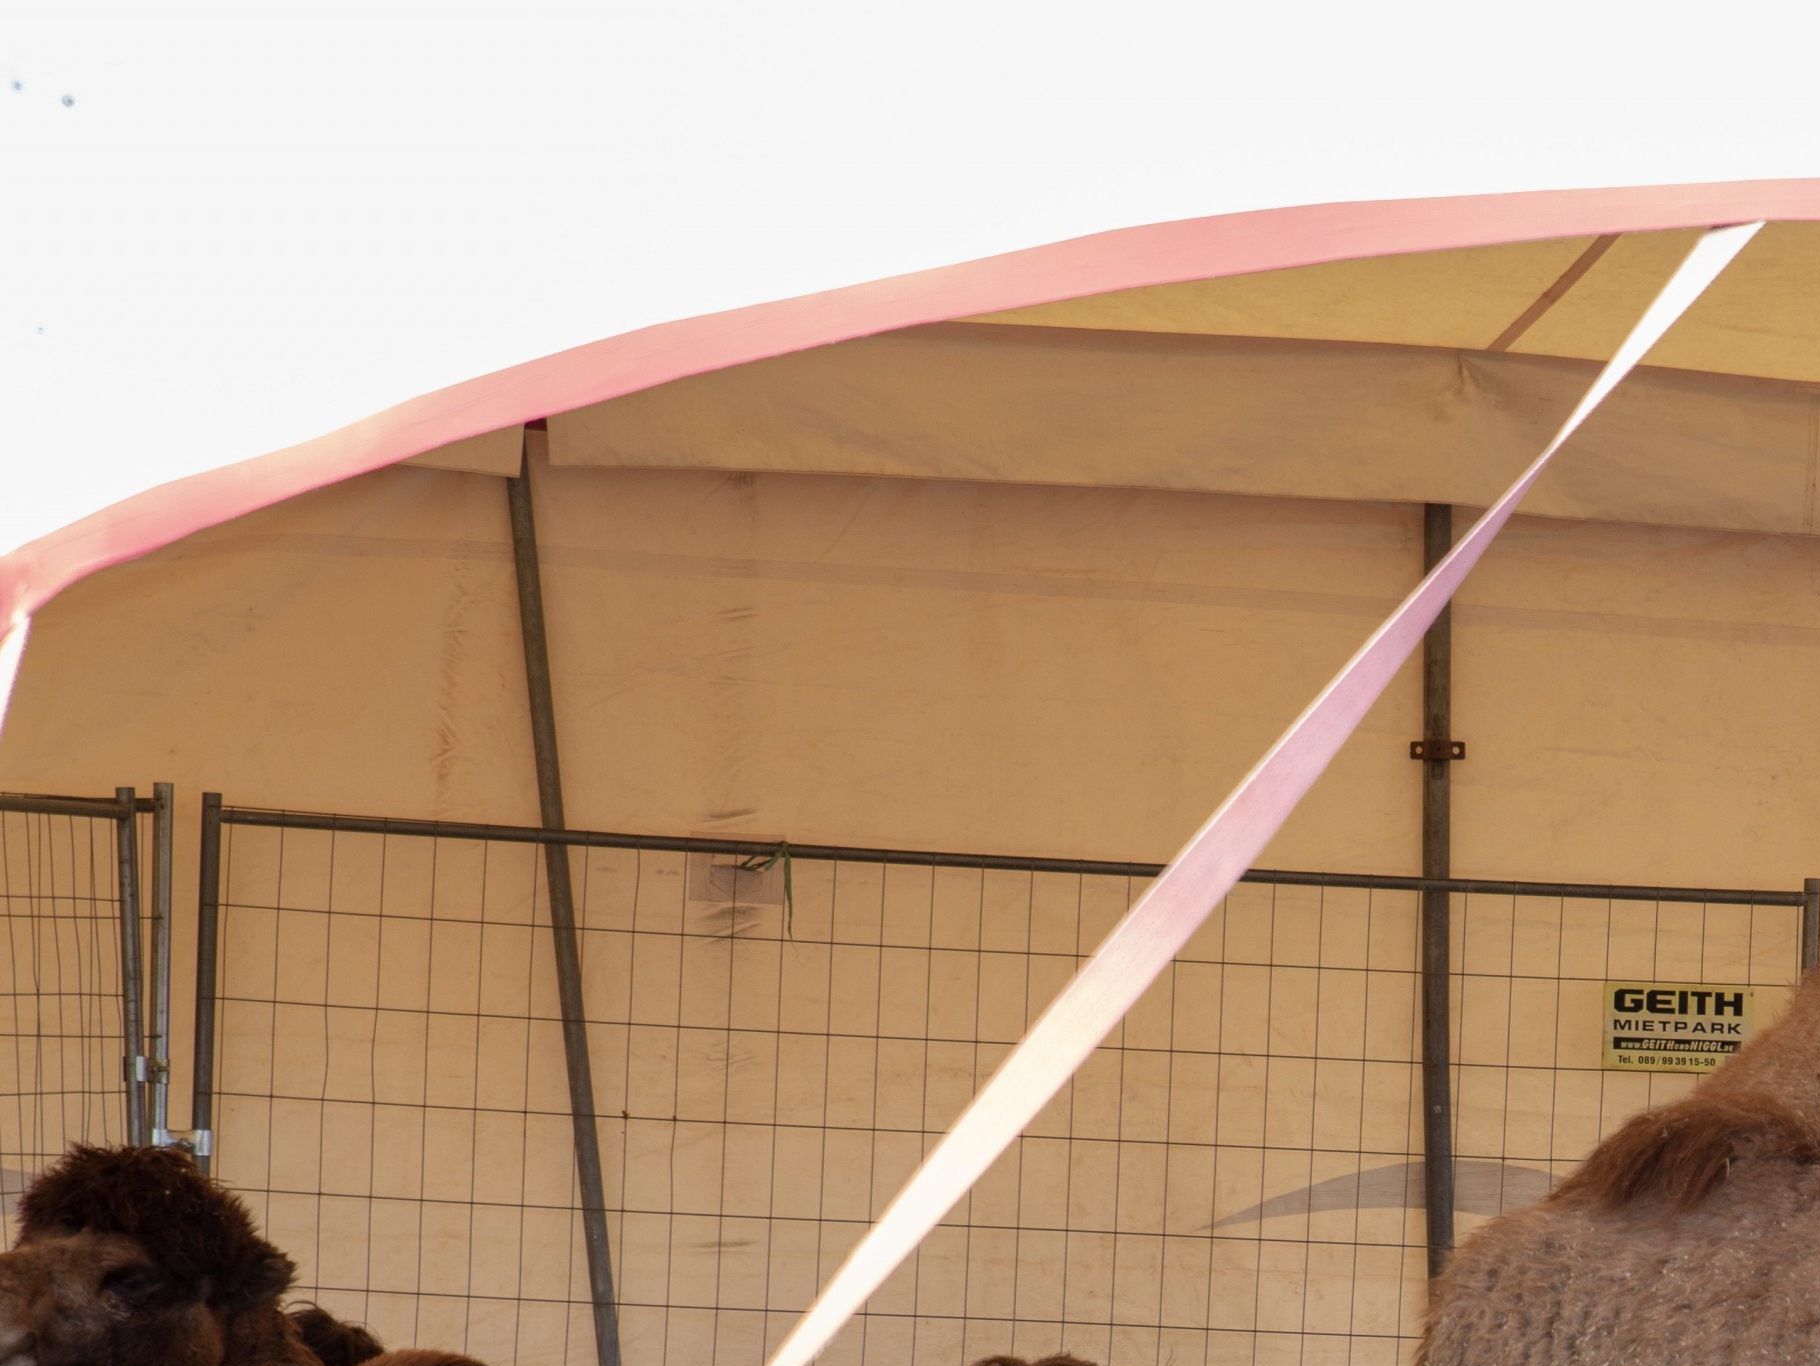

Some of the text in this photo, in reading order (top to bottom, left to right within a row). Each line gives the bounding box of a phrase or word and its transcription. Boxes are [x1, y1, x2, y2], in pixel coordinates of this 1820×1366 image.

[1613, 988, 1744, 1017] GEITH
[1613, 1019, 1742, 1035] MIETPARK
[1618, 1055, 1634, 1065] Tel.
